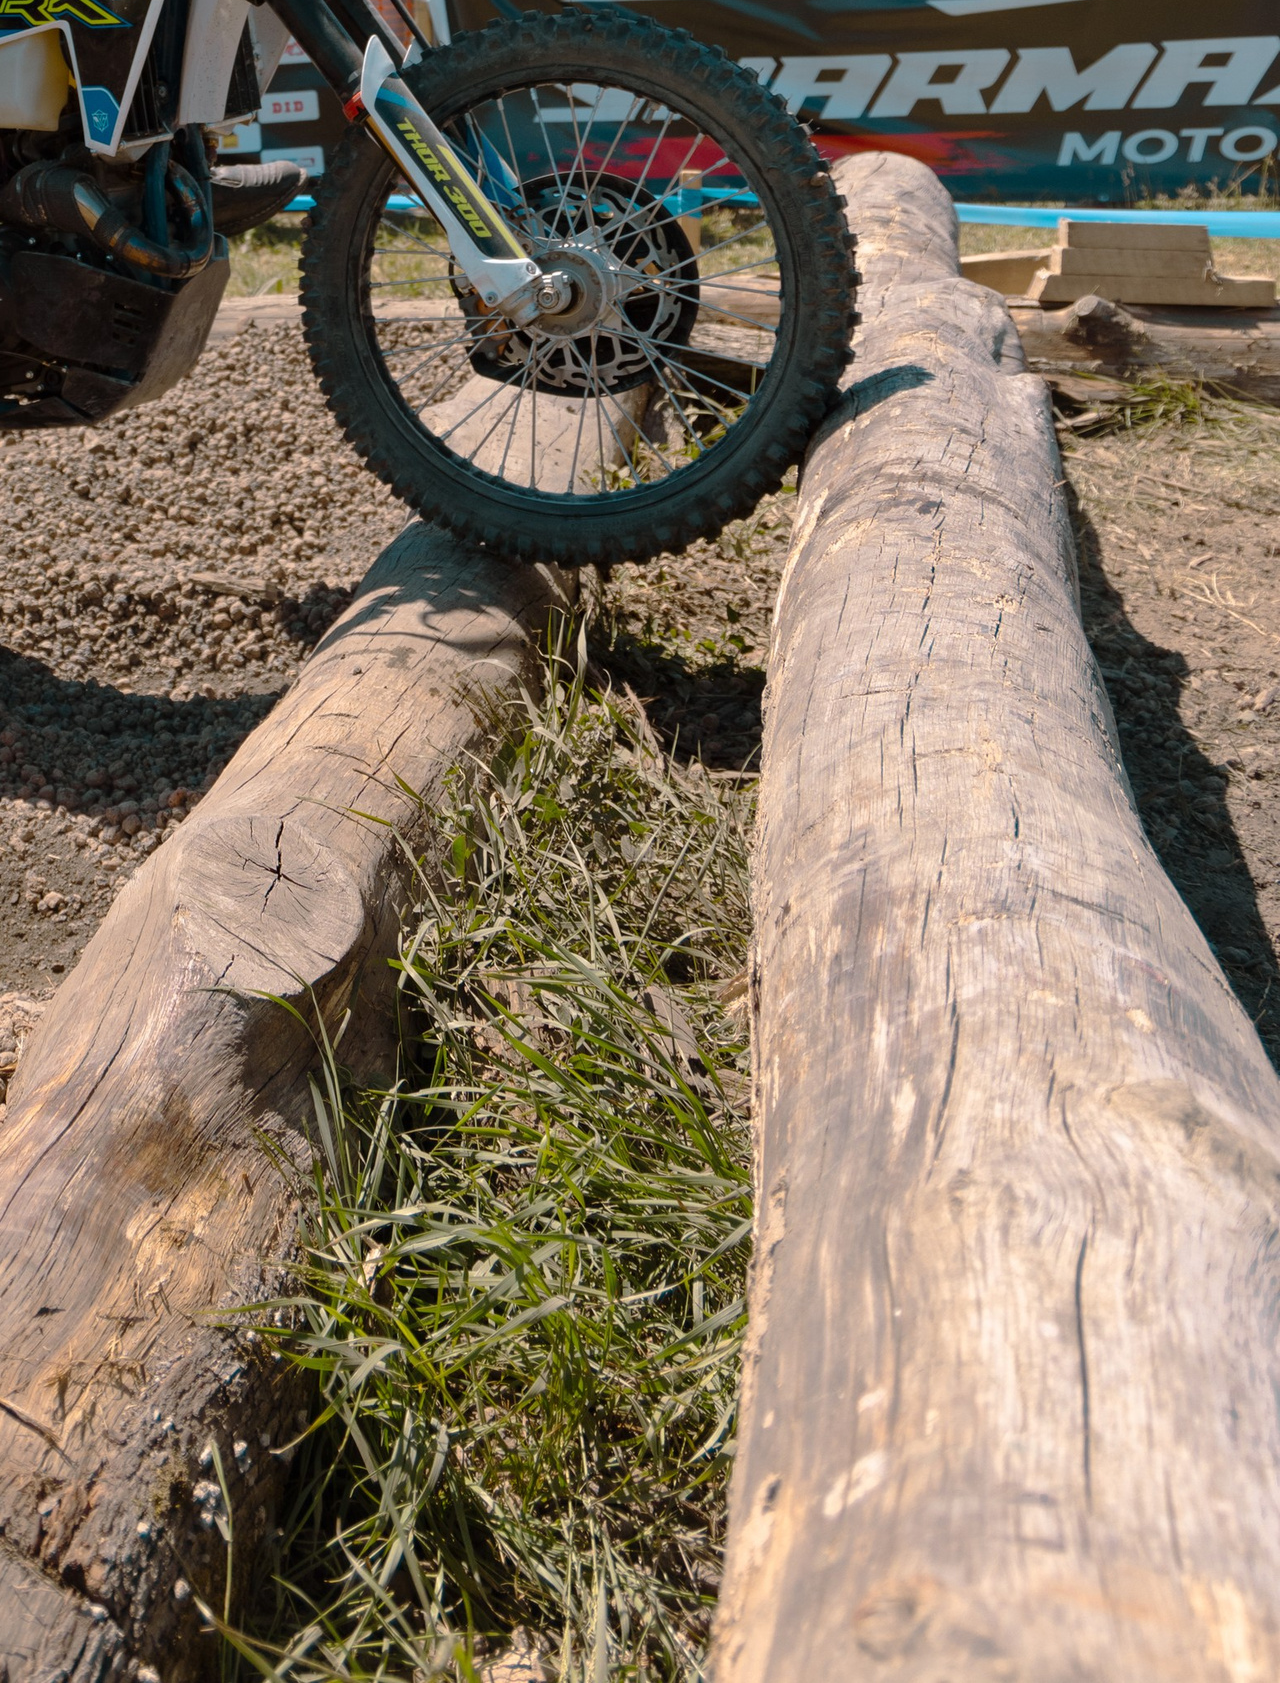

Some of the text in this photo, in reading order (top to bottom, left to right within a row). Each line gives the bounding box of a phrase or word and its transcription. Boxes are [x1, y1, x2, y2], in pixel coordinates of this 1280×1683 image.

[396, 116, 493, 238] THOR 300
[1056, 125, 1280, 167] MOTO
